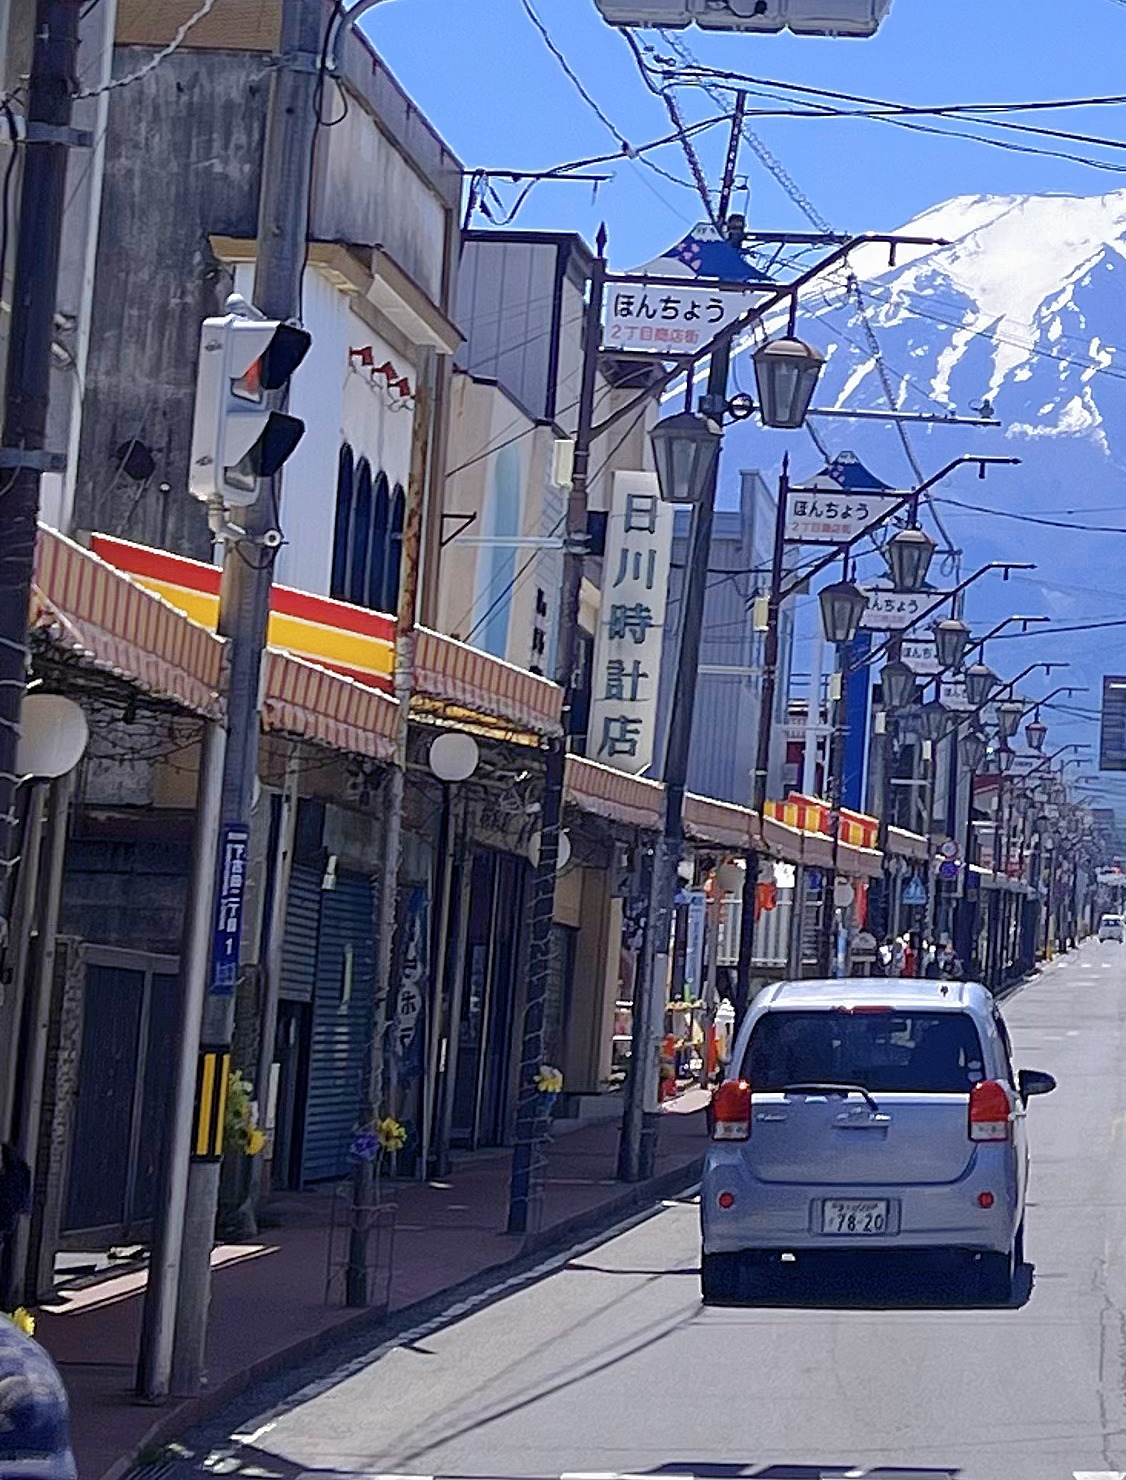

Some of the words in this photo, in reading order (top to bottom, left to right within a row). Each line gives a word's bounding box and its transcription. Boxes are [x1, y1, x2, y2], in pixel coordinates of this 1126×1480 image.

[614, 293, 725, 324] ほんちょう
[793, 500, 869, 521] ほんちょう
[598, 493, 658, 758] 日川時計店
